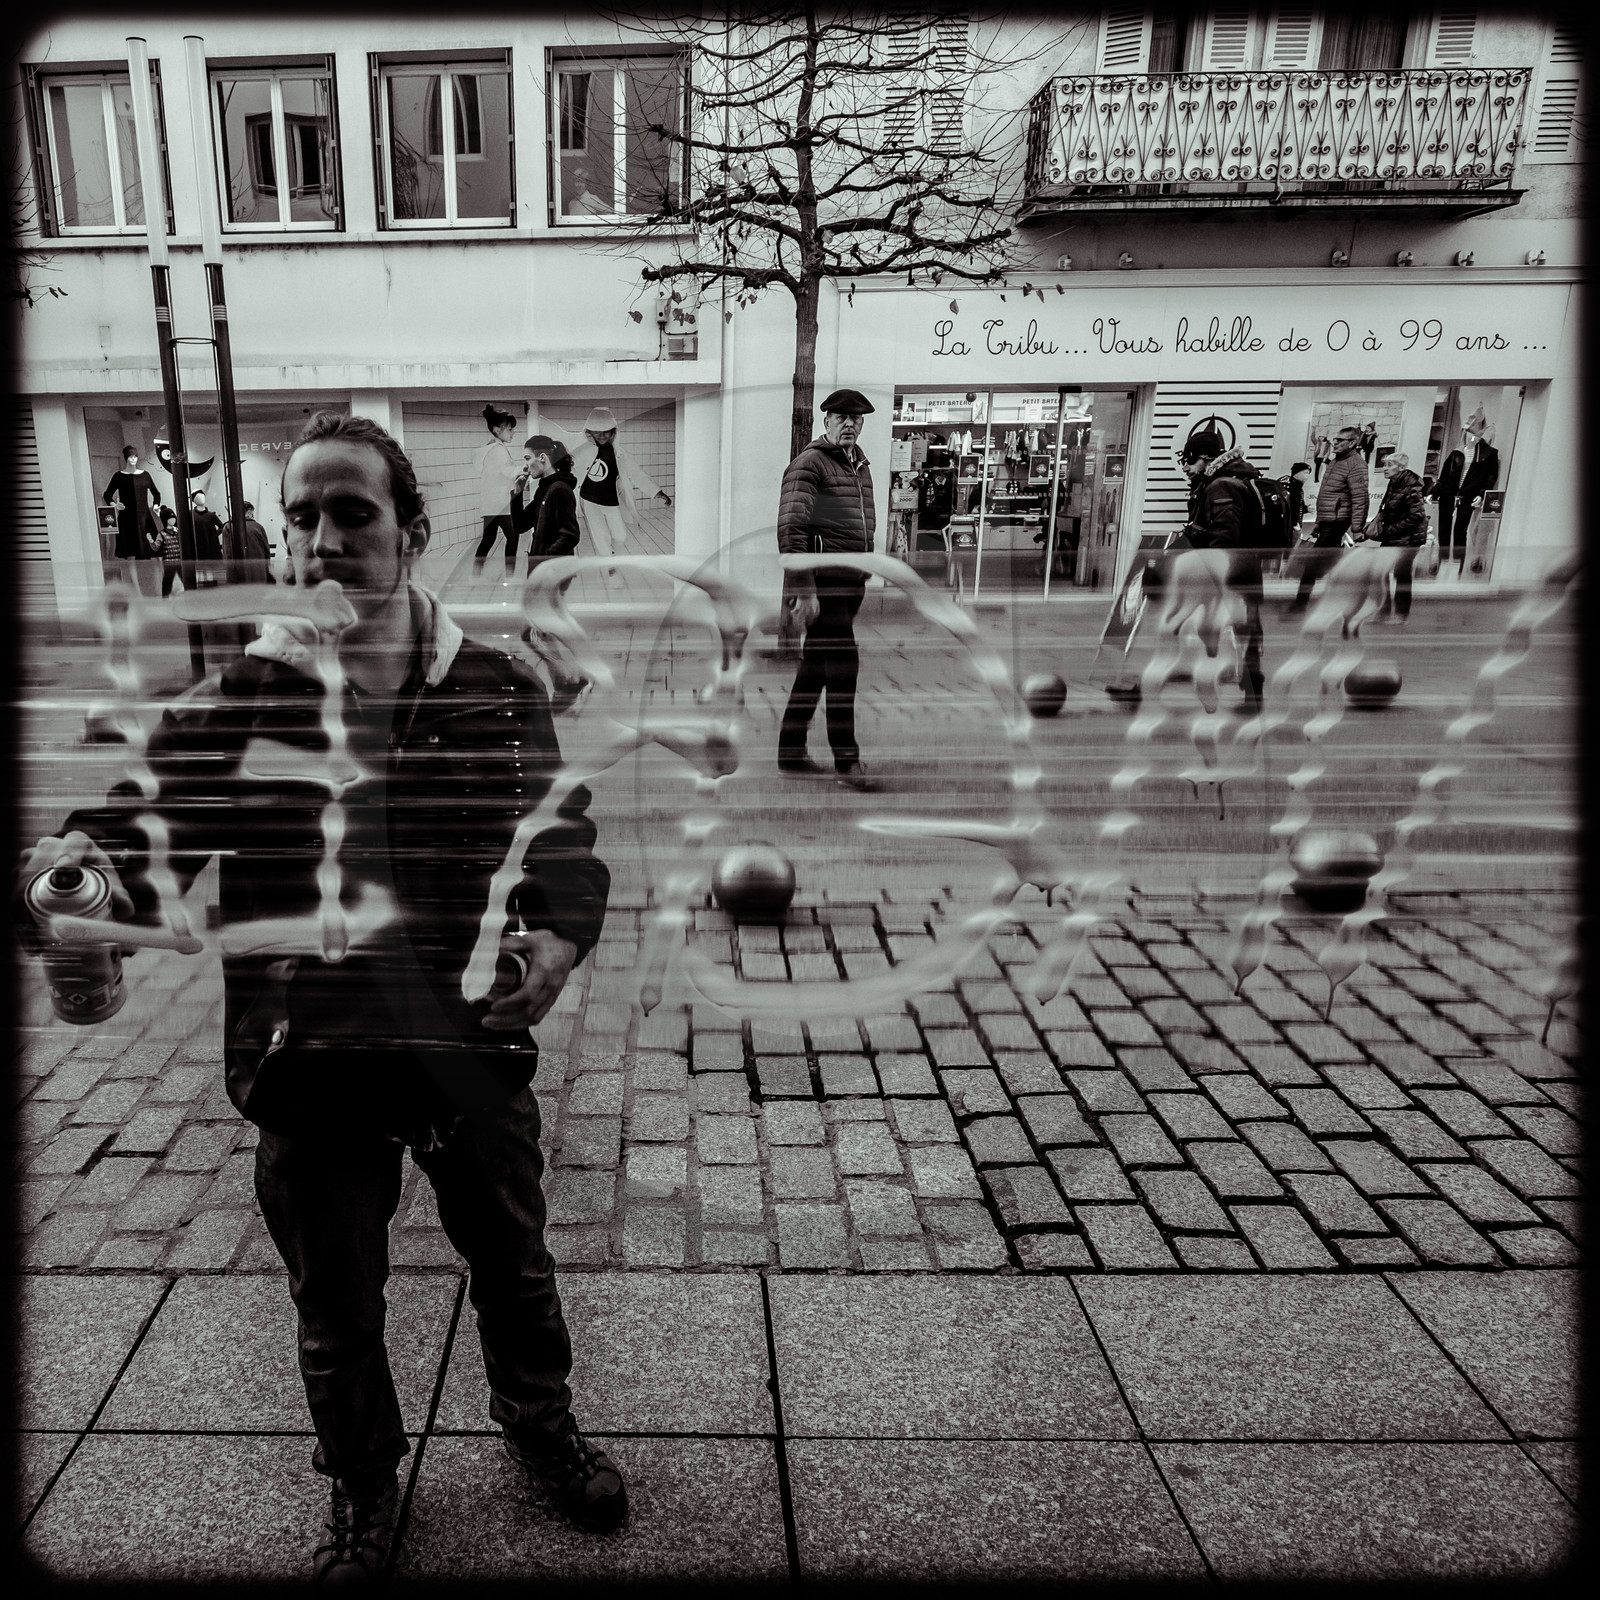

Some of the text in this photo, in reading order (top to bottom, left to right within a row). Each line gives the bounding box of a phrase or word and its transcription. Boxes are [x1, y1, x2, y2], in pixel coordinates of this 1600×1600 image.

[931, 319, 972, 356] La
[1175, 315, 1266, 353] habille
[1278, 327, 1313, 352] de
[1362, 329, 1383, 351] à
[1399, 319, 1443, 351] 99
